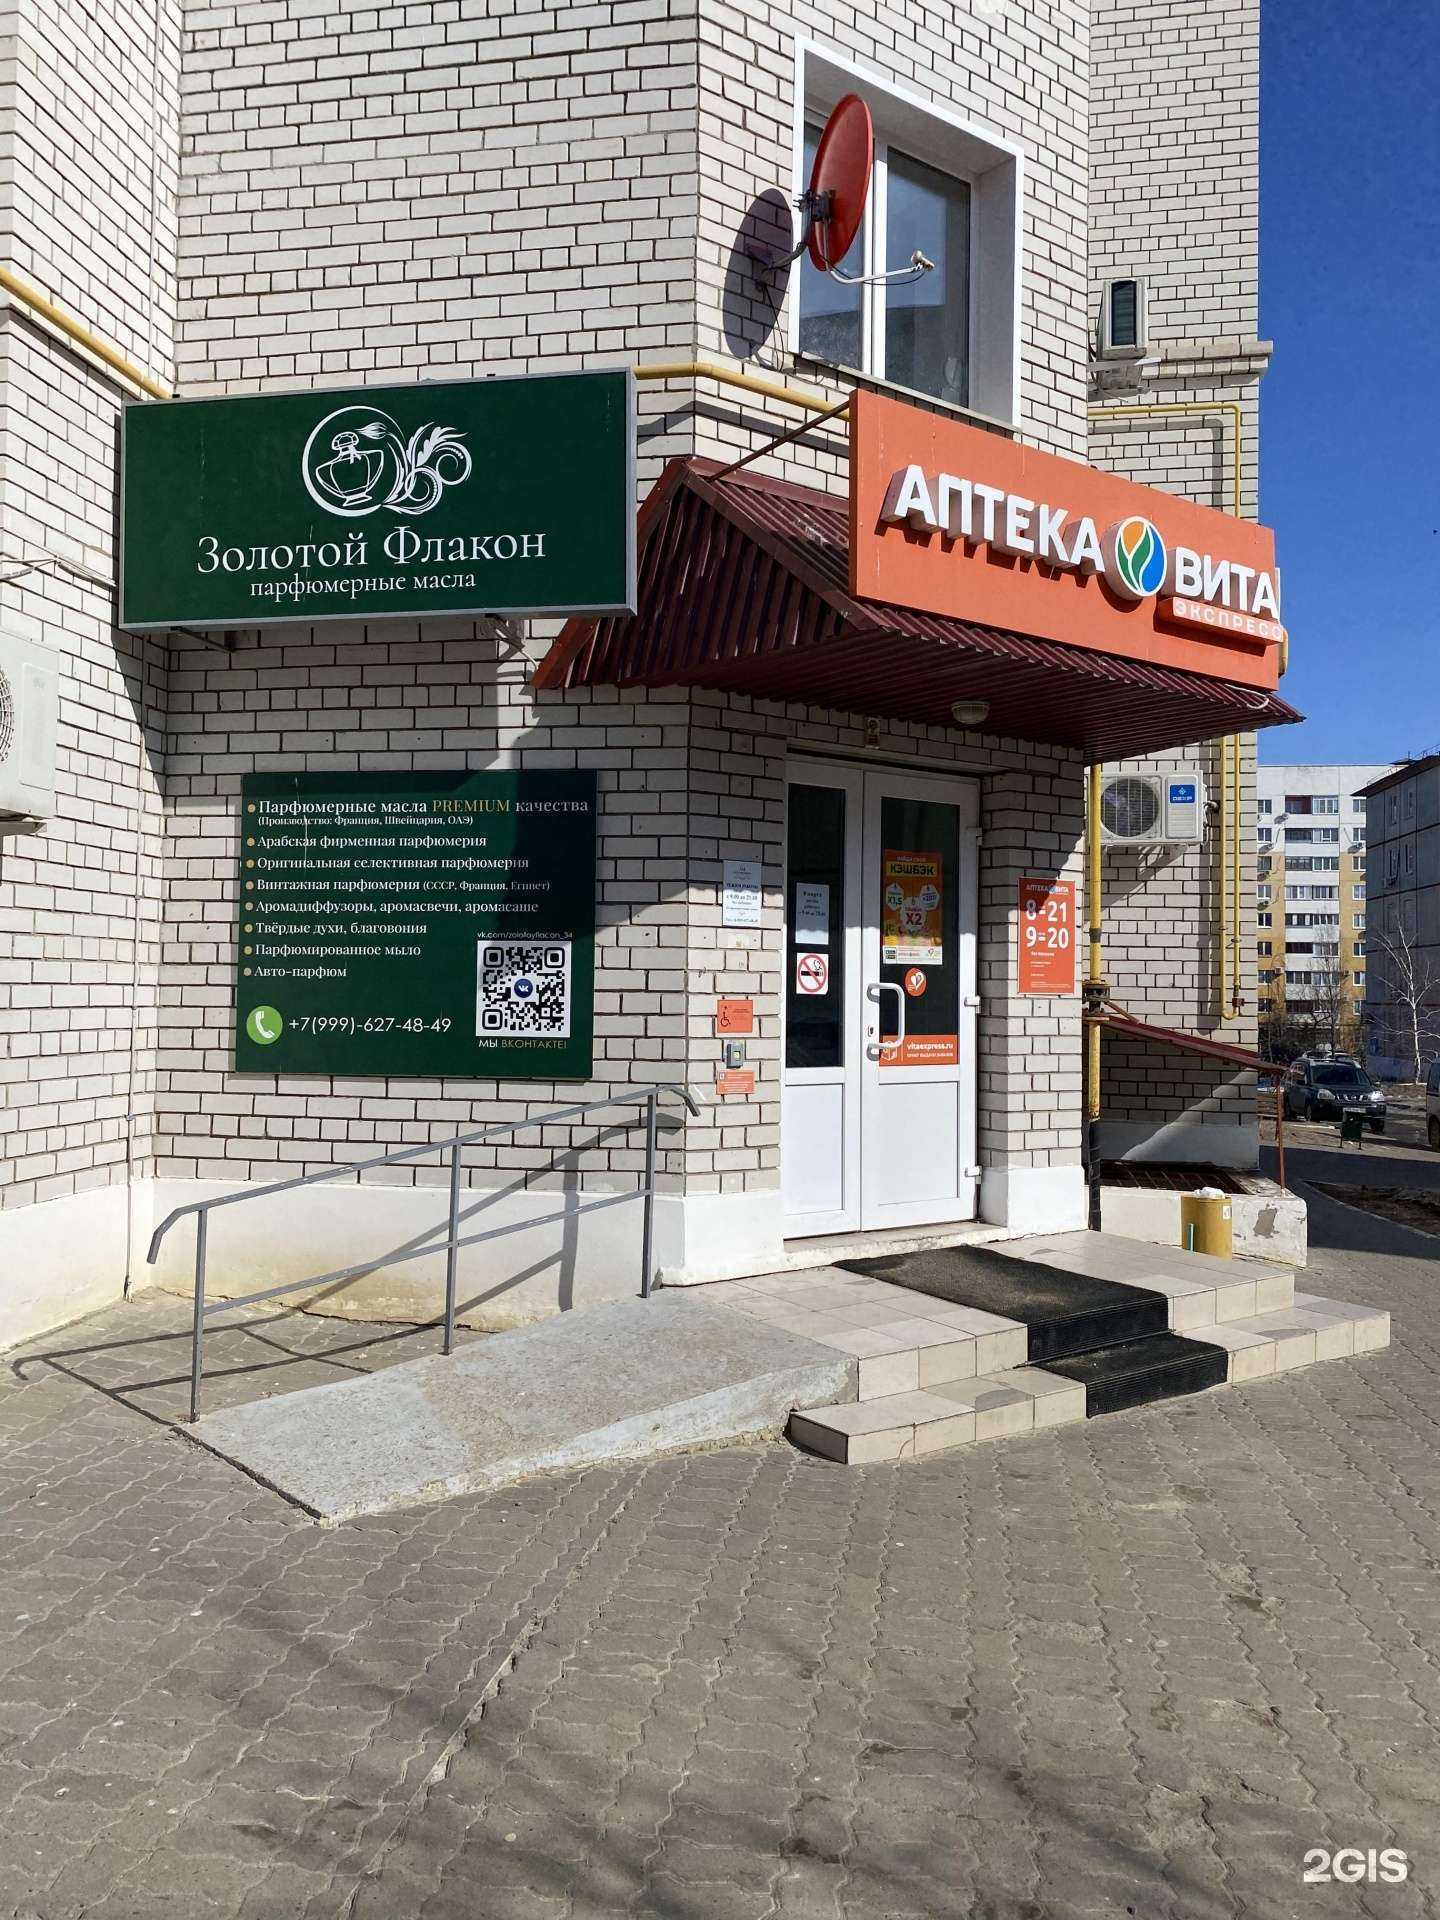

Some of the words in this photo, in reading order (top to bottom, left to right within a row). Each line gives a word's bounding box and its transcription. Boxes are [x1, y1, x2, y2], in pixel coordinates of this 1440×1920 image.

[894, 464, 1105, 573] АПТЕКА
[1175, 546, 1281, 619] ВИТА
[197, 533, 368, 574] Золотой
[383, 525, 546, 566] Флакон
[250, 573, 406, 602] парфюмерные
[412, 571, 476, 591] масла
[259, 801, 376, 815] Парфюмерные
[381, 801, 427, 813] масла
[432, 799, 510, 812] PREMIUM
[515, 800, 589, 812] качества
[334, 816, 383, 827] Франция,
[384, 816, 446, 826] Швейцария,
[447, 815, 474, 826] ОАЭ)
[257, 836, 317, 849] Арабская
[320, 836, 396, 849] фирменная
[399, 835, 487, 849] парфюмерия
[257, 858, 351, 871] Оригинальная
[354, 858, 438, 869] селективная
[441, 857, 529, 871] парфюмерия
[256, 880, 331, 891] Винтажная
[333, 879, 420, 893] парфюмерия
[423, 881, 457, 891] (СССР,
[459, 880, 508, 891] Франция,
[256, 901, 377, 914] Аромадиффузоры,
[379, 903, 462, 914] аромасвечи,
[464, 903, 539, 913] аромасаше
[256, 922, 311, 934] Твёрдые
[313, 924, 347, 936] духи,
[350, 922, 427, 934] благовония
[255, 944, 383, 958] Парфюмированное
[386, 946, 421, 956] мыло
[254, 966, 347, 979] Авто-парфюм
[288, 1017, 452, 1036] +7(999)-627-48-49
[479, 1039, 498, 1048] МЫ
